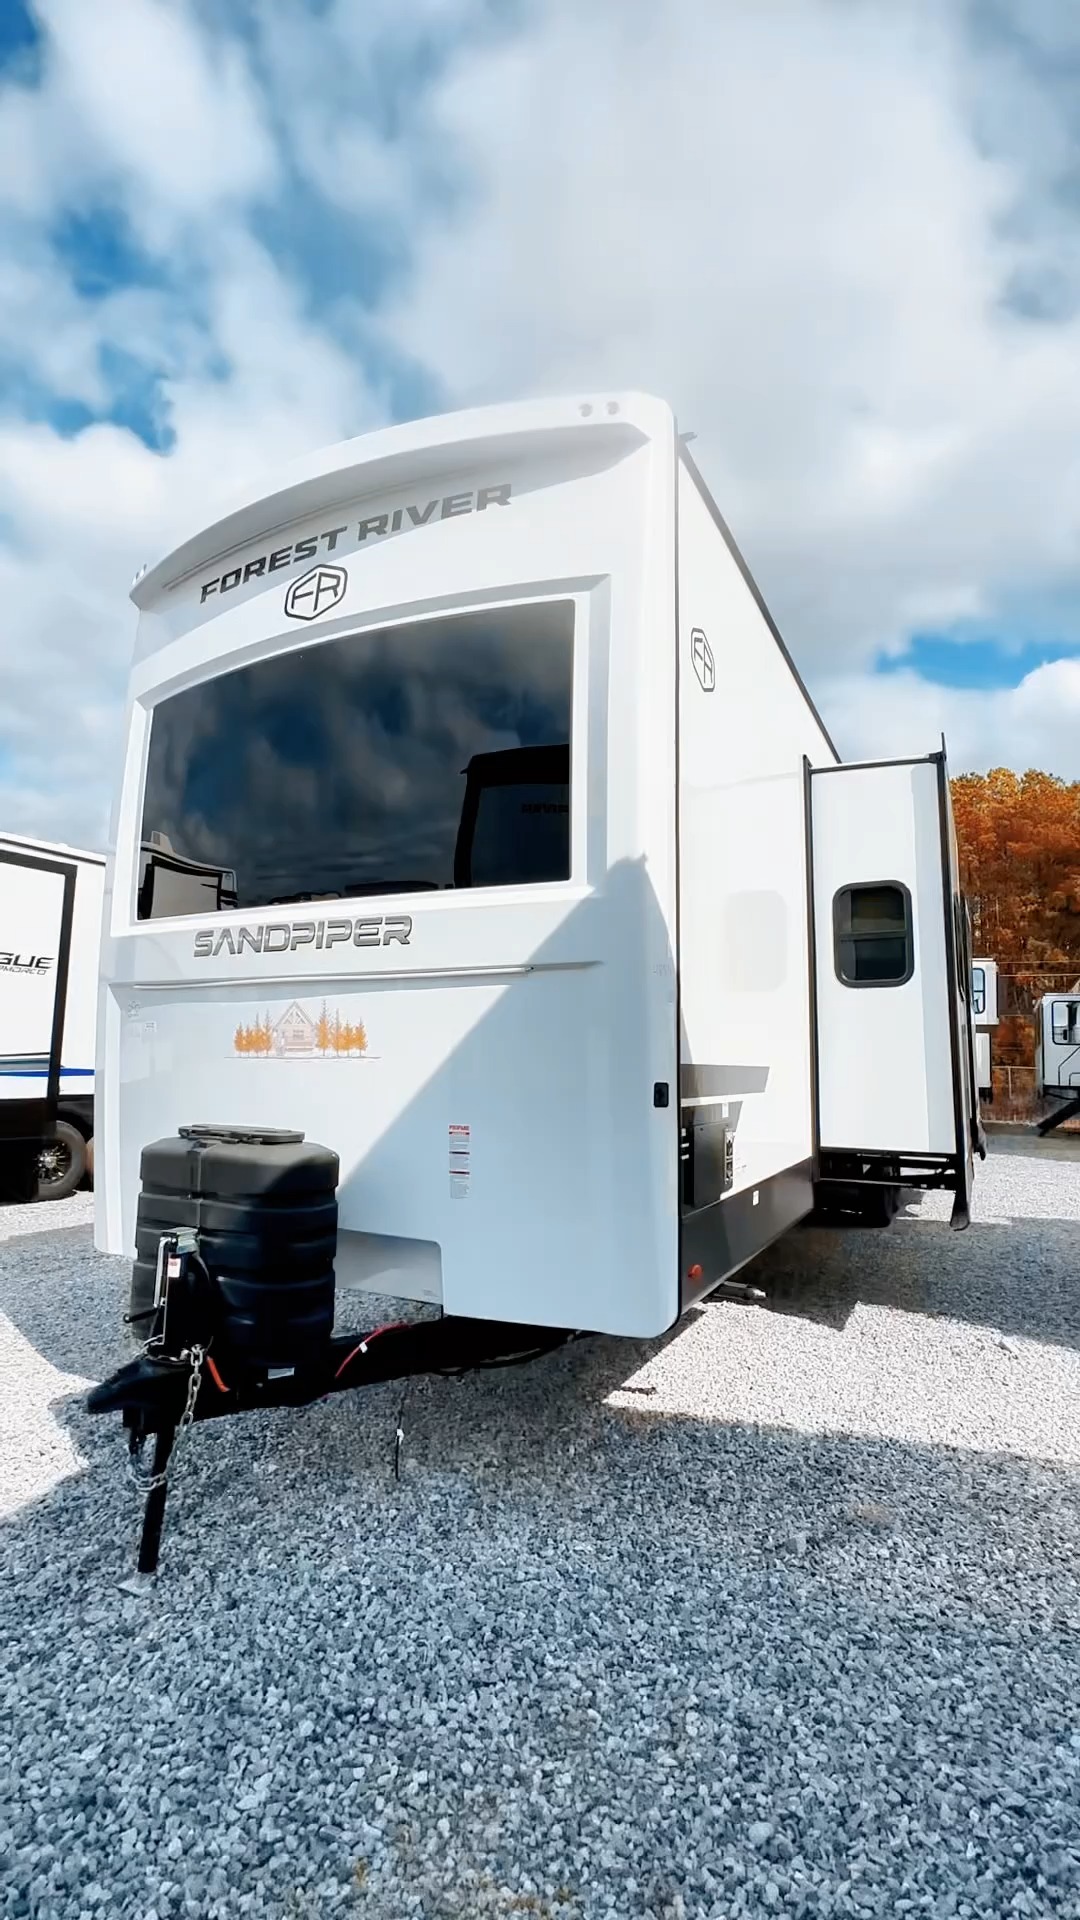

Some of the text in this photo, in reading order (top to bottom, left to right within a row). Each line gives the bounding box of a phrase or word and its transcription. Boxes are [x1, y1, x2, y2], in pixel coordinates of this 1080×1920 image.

[200, 483, 512, 604] FOREST RIVER
[290, 570, 342, 613] FR
[193, 915, 413, 958] SANDPIPER
